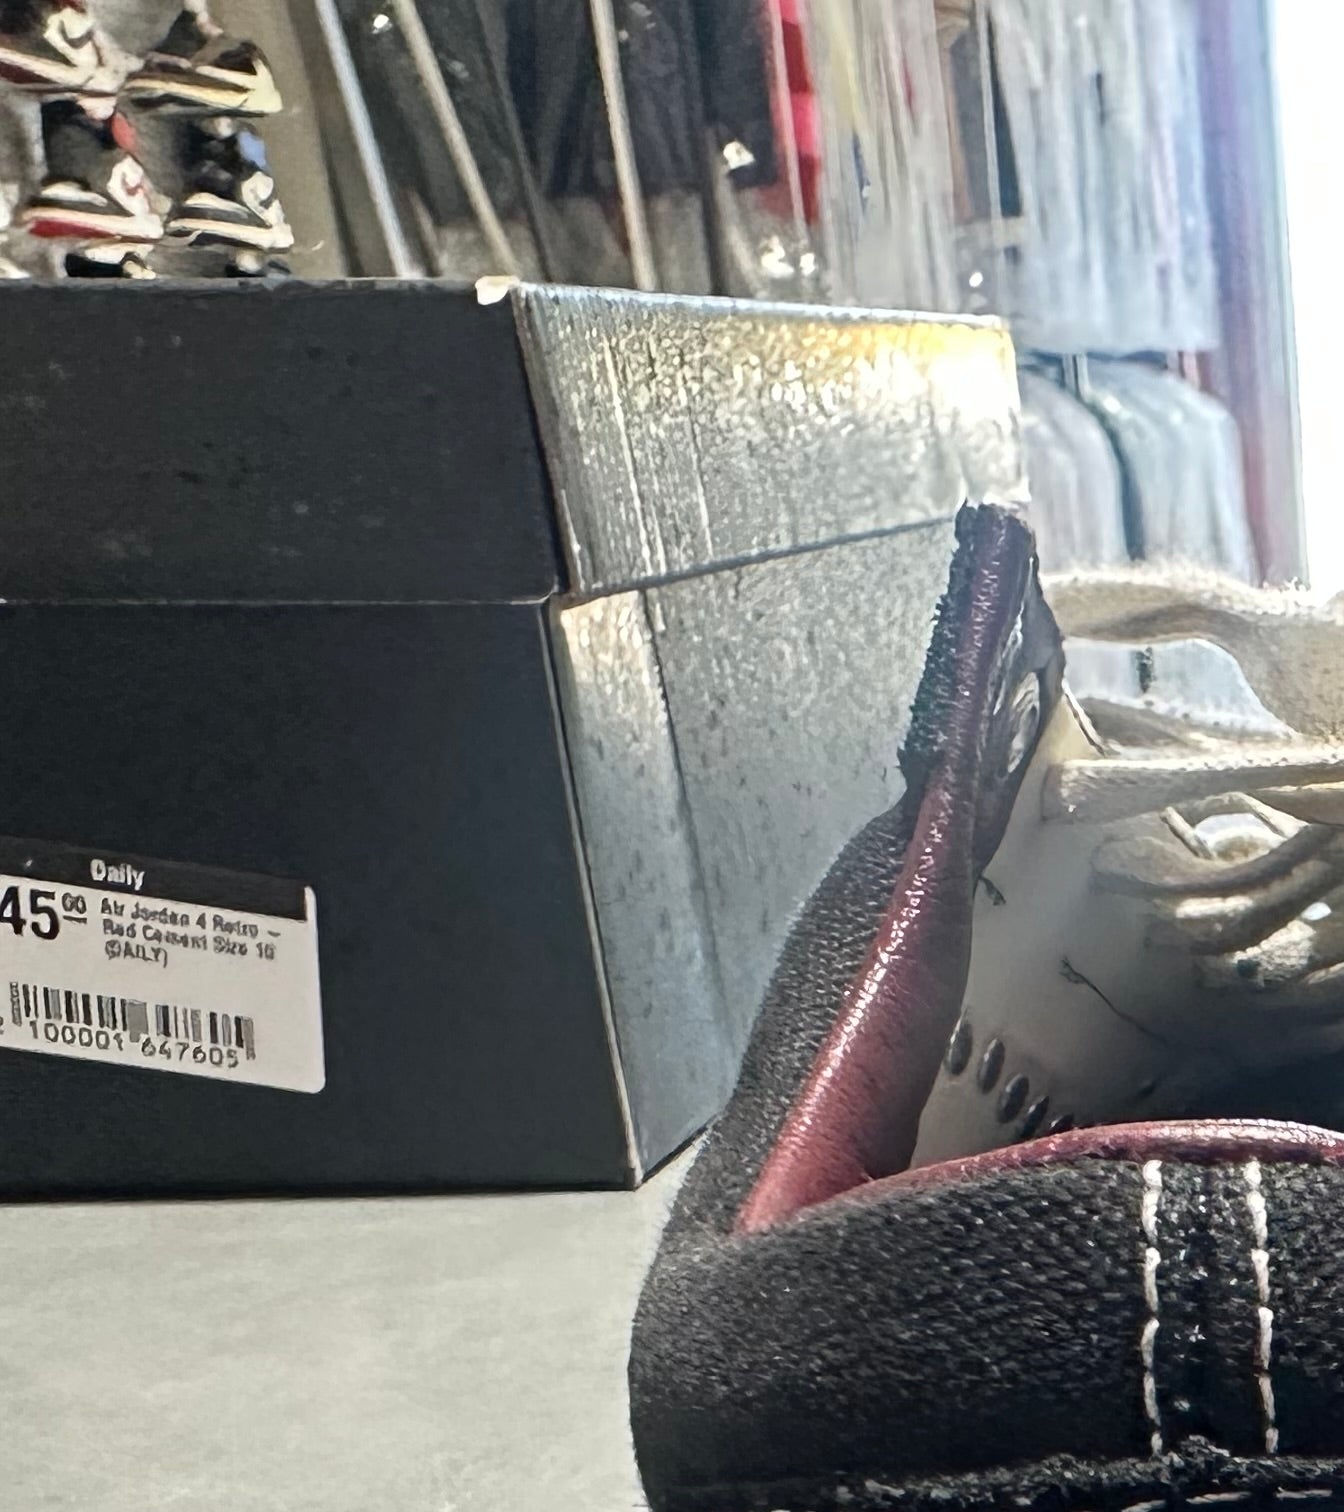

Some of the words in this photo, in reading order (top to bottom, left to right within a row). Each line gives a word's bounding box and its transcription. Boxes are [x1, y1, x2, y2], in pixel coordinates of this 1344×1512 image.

[90, 858, 146, 890] Daily
[101, 897, 125, 917] Air
[131, 901, 190, 927] Jordan
[212, 914, 259, 939] Retro
[102, 918, 137, 938] Red
[142, 924, 208, 950] Cement
[213, 935, 248, 956] Size
[256, 942, 276, 960] 10
[29, 1019, 124, 1051] 100001
